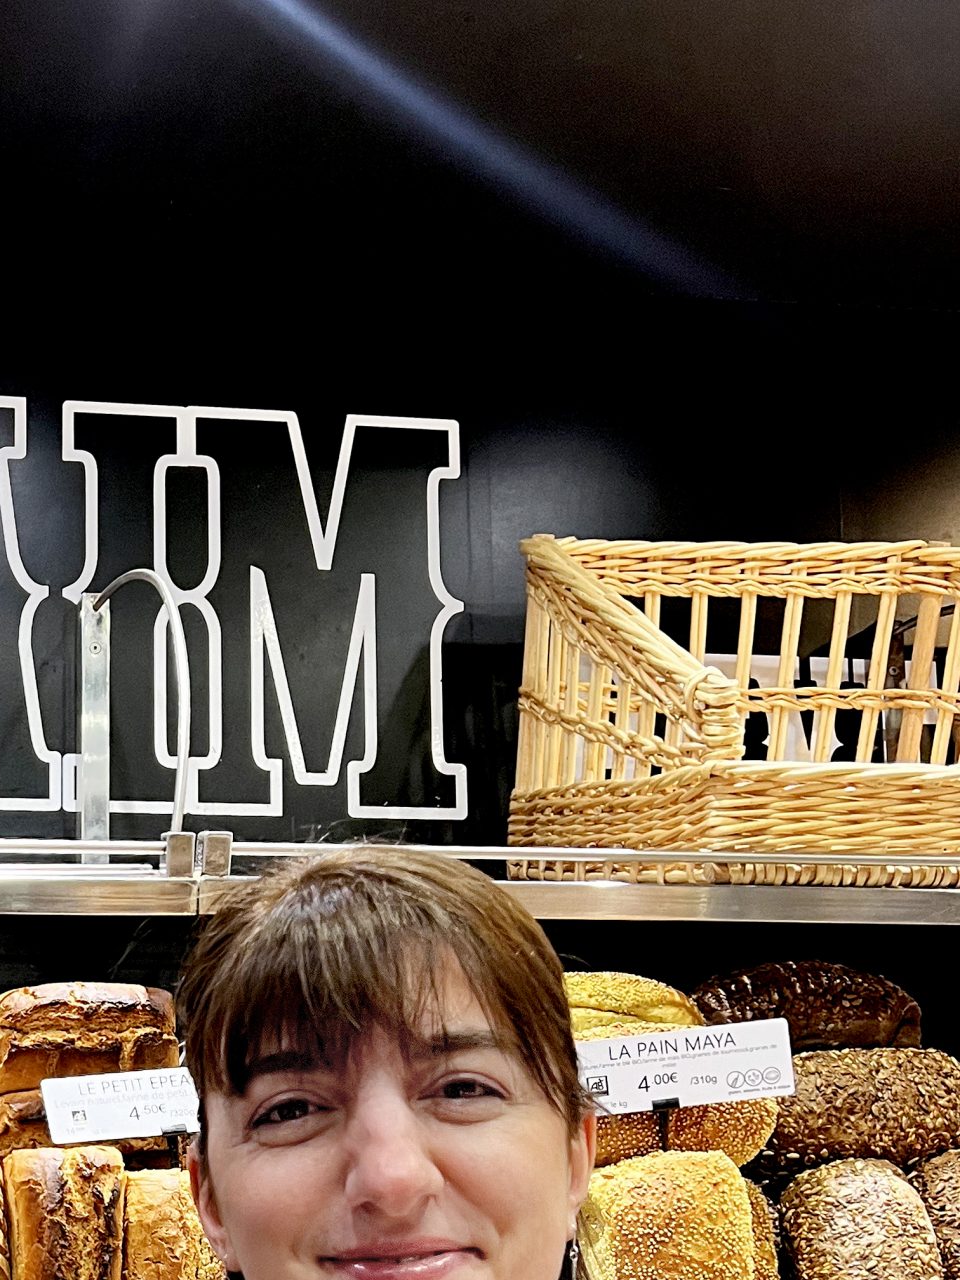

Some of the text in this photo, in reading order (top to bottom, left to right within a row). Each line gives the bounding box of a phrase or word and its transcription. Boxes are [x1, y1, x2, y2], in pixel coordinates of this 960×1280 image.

[608, 1044, 631, 1061] LA
[637, 1038, 678, 1058] PAIN
[685, 1032, 737, 1052] MAYA
[78, 1081, 97, 1096] LE
[101, 1078, 144, 1094] PETIT
[690, 1075, 718, 1086] /310g
